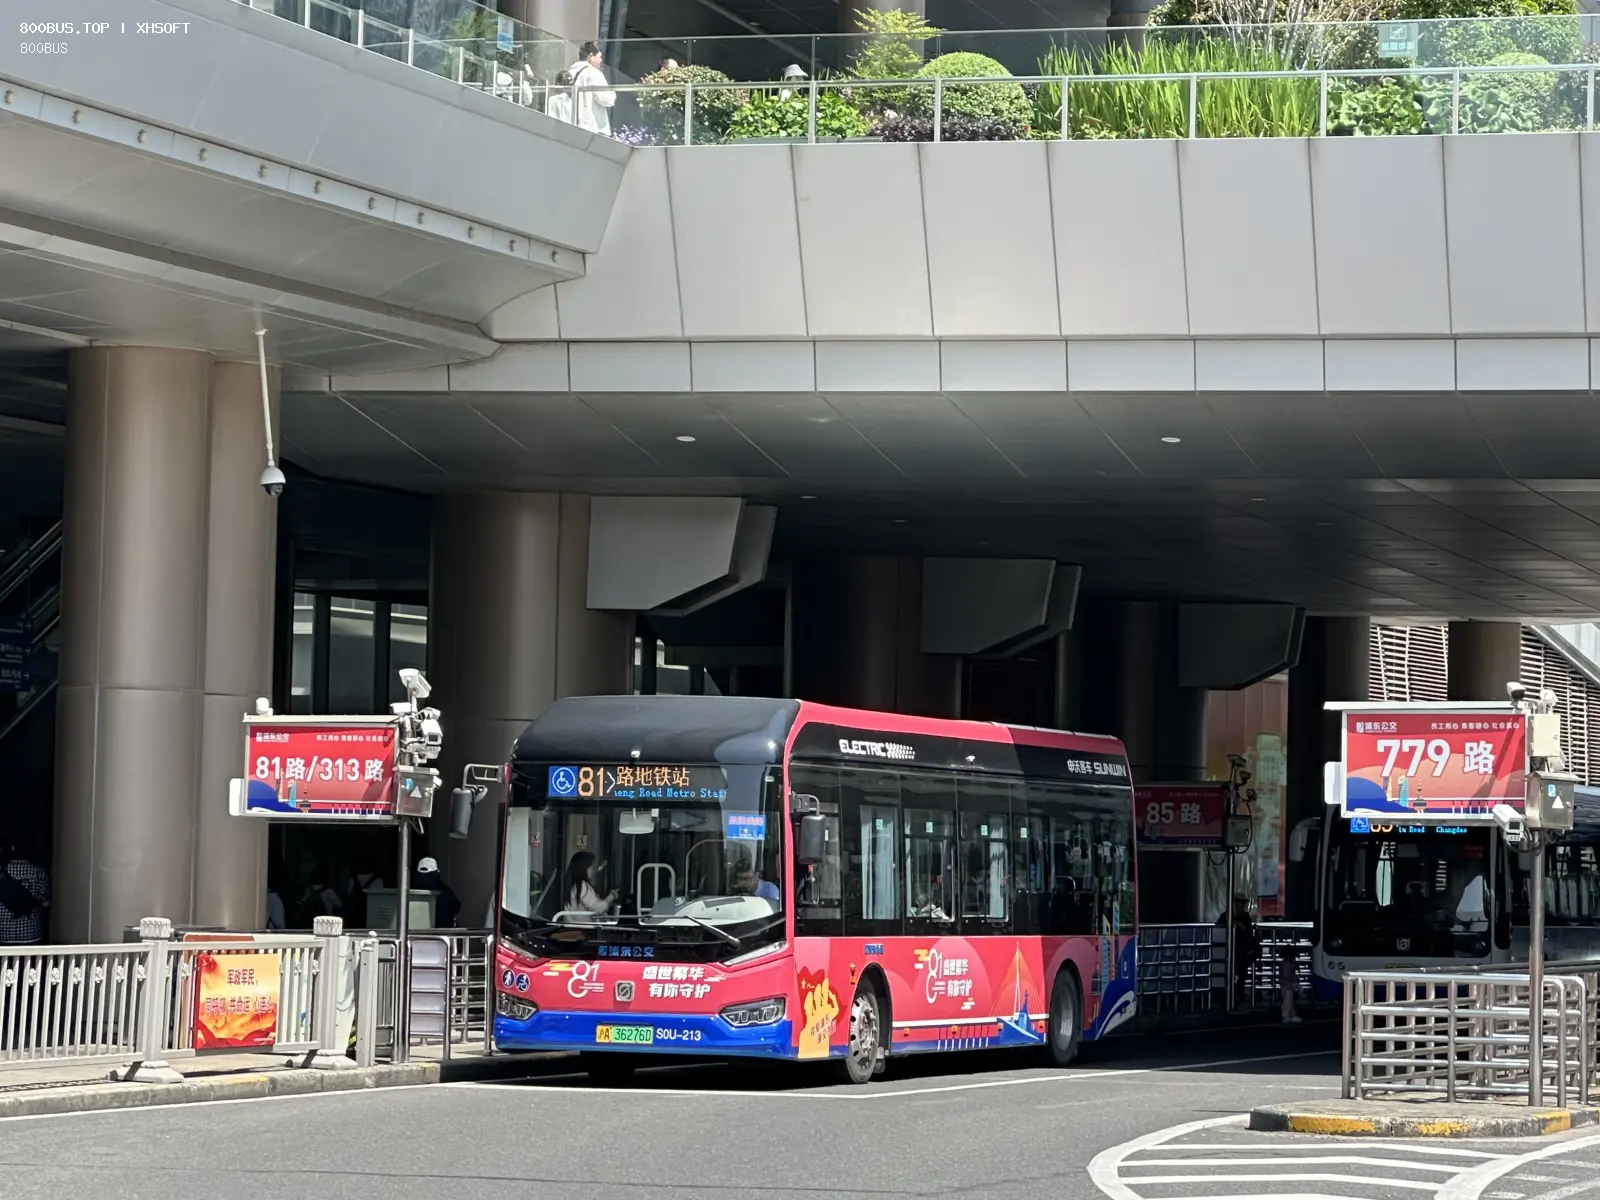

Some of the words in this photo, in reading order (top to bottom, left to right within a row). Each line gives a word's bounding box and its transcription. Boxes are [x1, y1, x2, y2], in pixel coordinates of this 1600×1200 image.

[838, 739, 887, 757] ELECTRIC
[1376, 738, 1451, 778] 779
[616, 766, 691, 787] 路地铁站
[1093, 762, 1127, 777] SUNWIN
[578, 766, 604, 797] 81
[639, 787, 662, 798] Road
[666, 787, 696, 798] Metro
[1146, 801, 1175, 825] 85
[608, 945, 655, 957] 浦东公交
[641, 965, 705, 981] 盛世繁华
[943, 958, 969, 976] 盛世繁华
[648, 983, 711, 999] 有你守护
[947, 979, 973, 998] 有你守护
